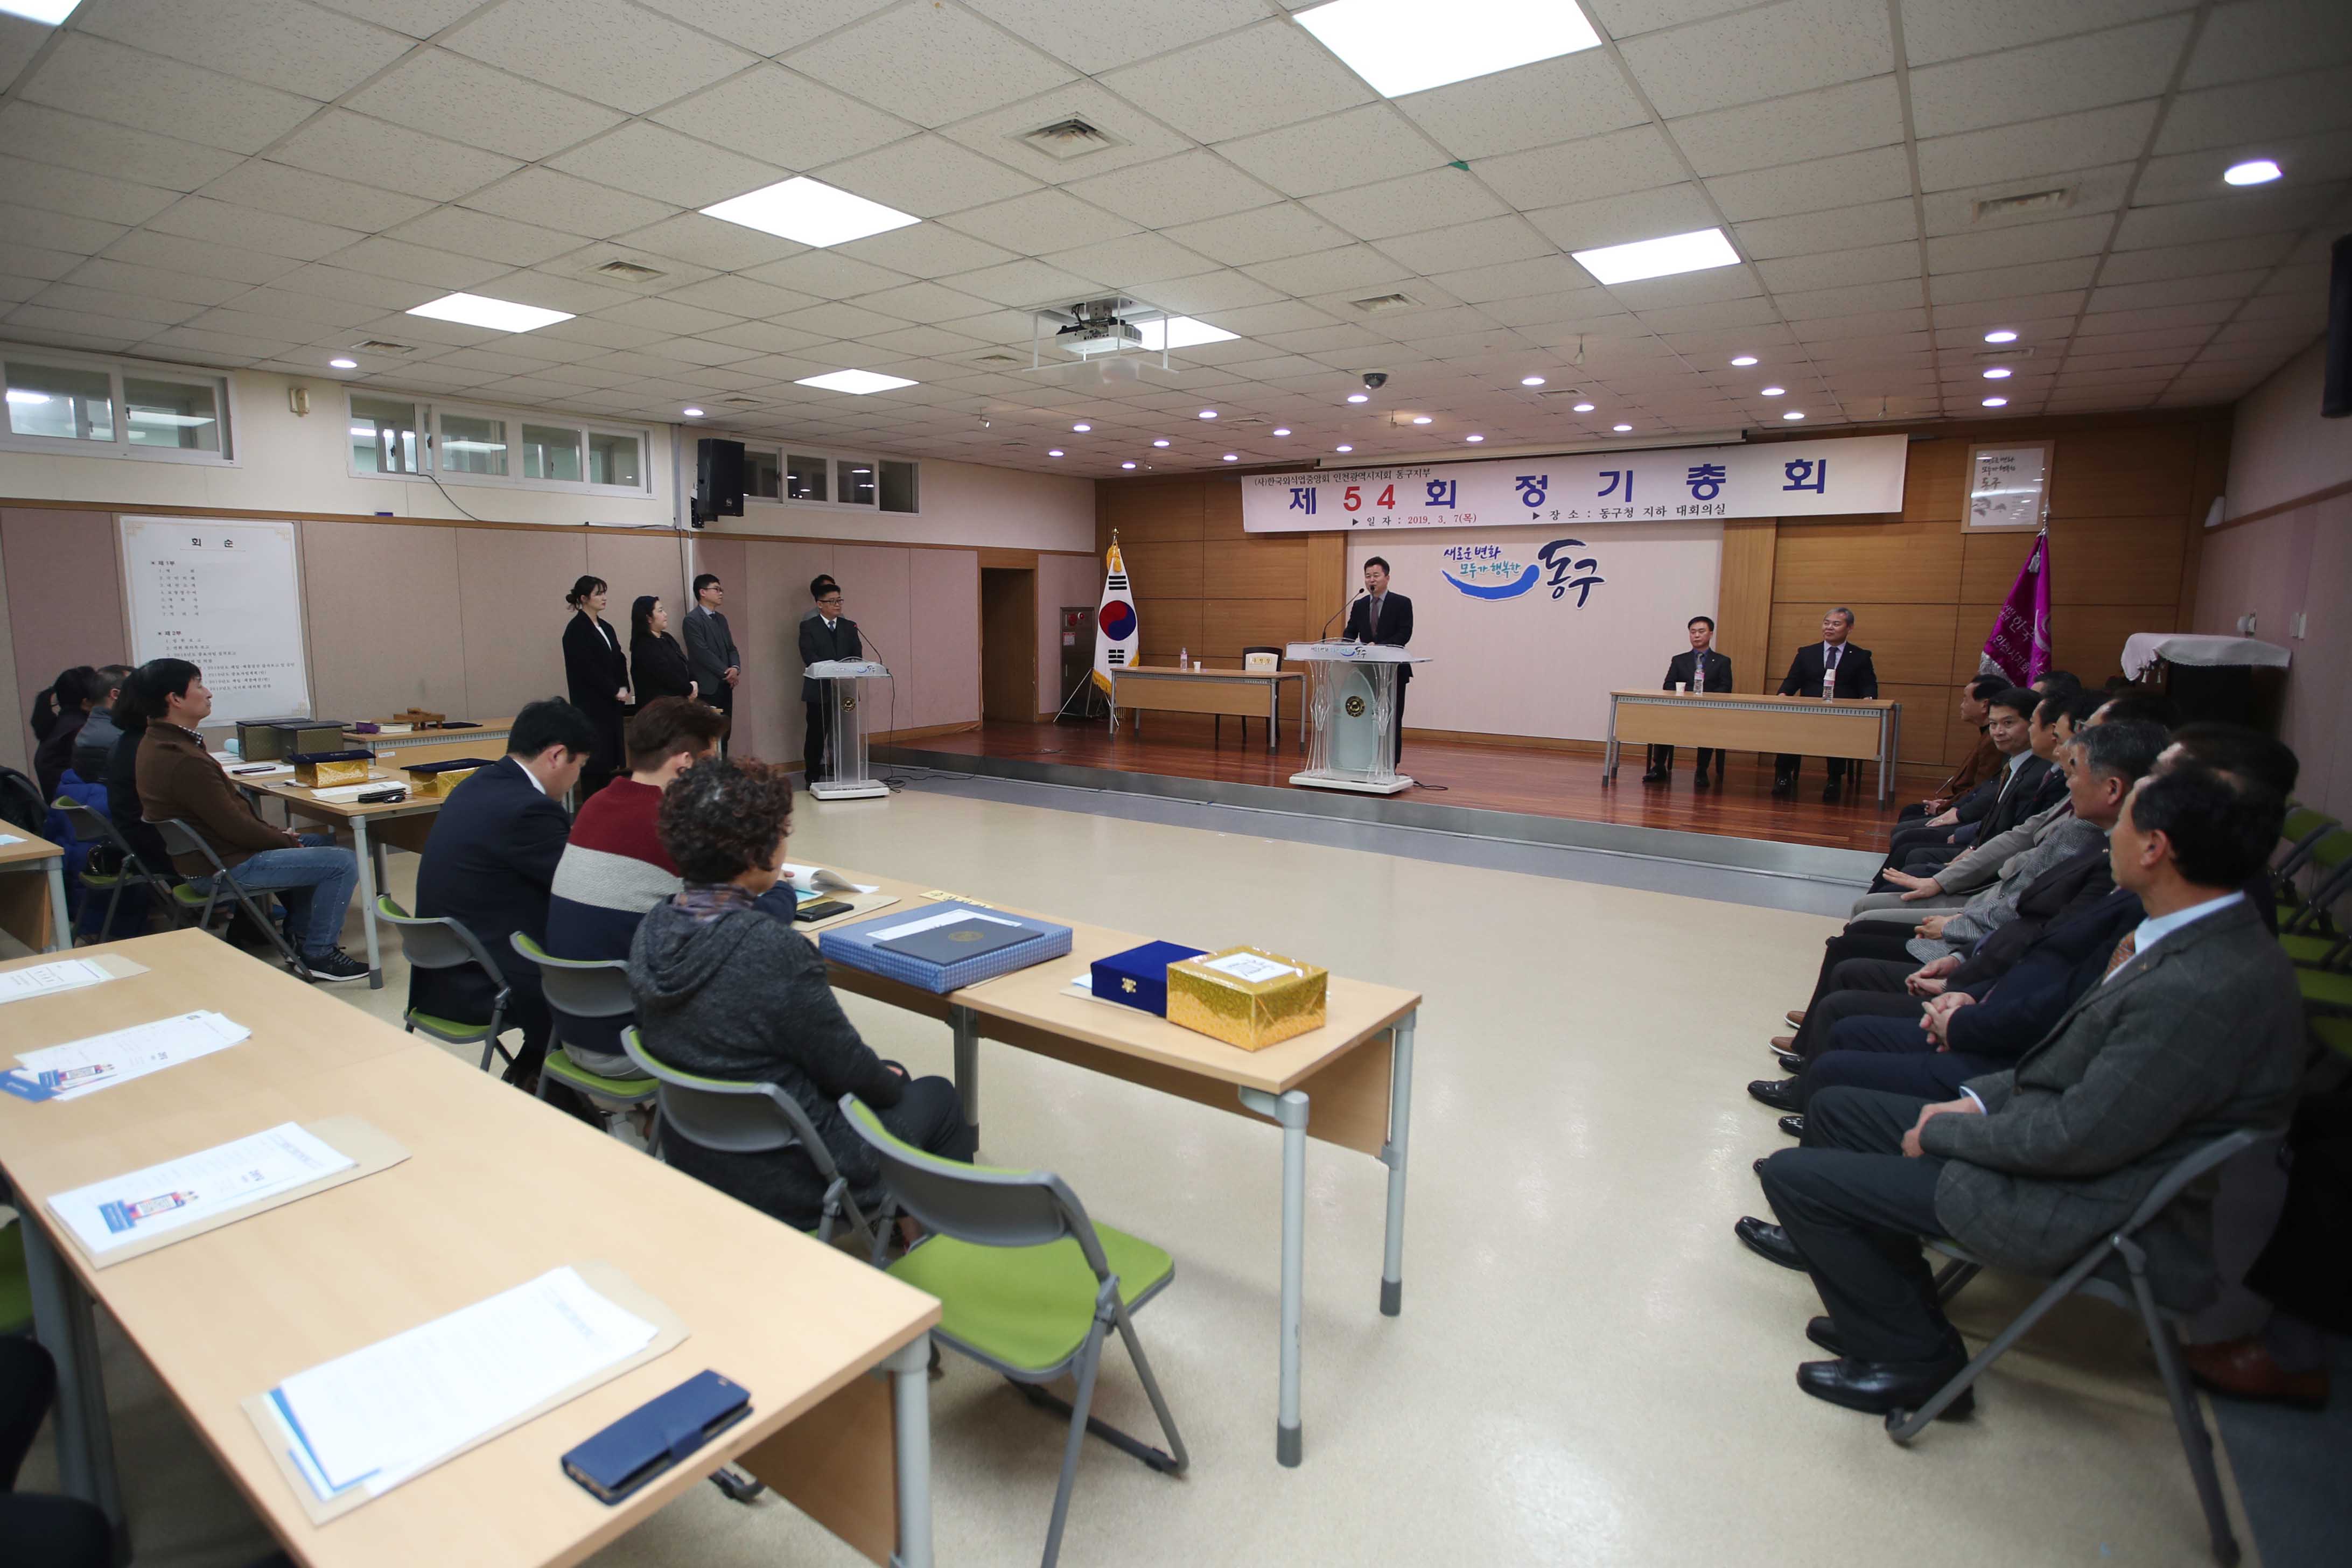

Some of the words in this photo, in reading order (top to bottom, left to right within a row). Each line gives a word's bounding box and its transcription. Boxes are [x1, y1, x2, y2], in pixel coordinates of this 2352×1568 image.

[1255, 473, 1329, 486] (사)한국외식업중앙회
[1333, 470, 1391, 483] 인천광역시지회
[1396, 468, 1430, 479] 동구지부
[1290, 487, 1316, 515] 제
[1343, 484, 1396, 511] 54
[1425, 479, 1457, 509] 회
[1408, 516, 1430, 524] 2019.
[1439, 515, 1446, 524] 3.
[1454, 513, 1476, 523] 7(목)
[1599, 507, 1634, 519] 동구청
[1643, 506, 1667, 517] 지하
[1676, 503, 1726, 516] 대회의실
[1444, 547, 1472, 561] 새로운
[1474, 545, 1501, 559] 변화
[1460, 563, 1488, 578] 모두가
[1490, 560, 1521, 578] 행복한
[1538, 539, 1605, 607] 동구
